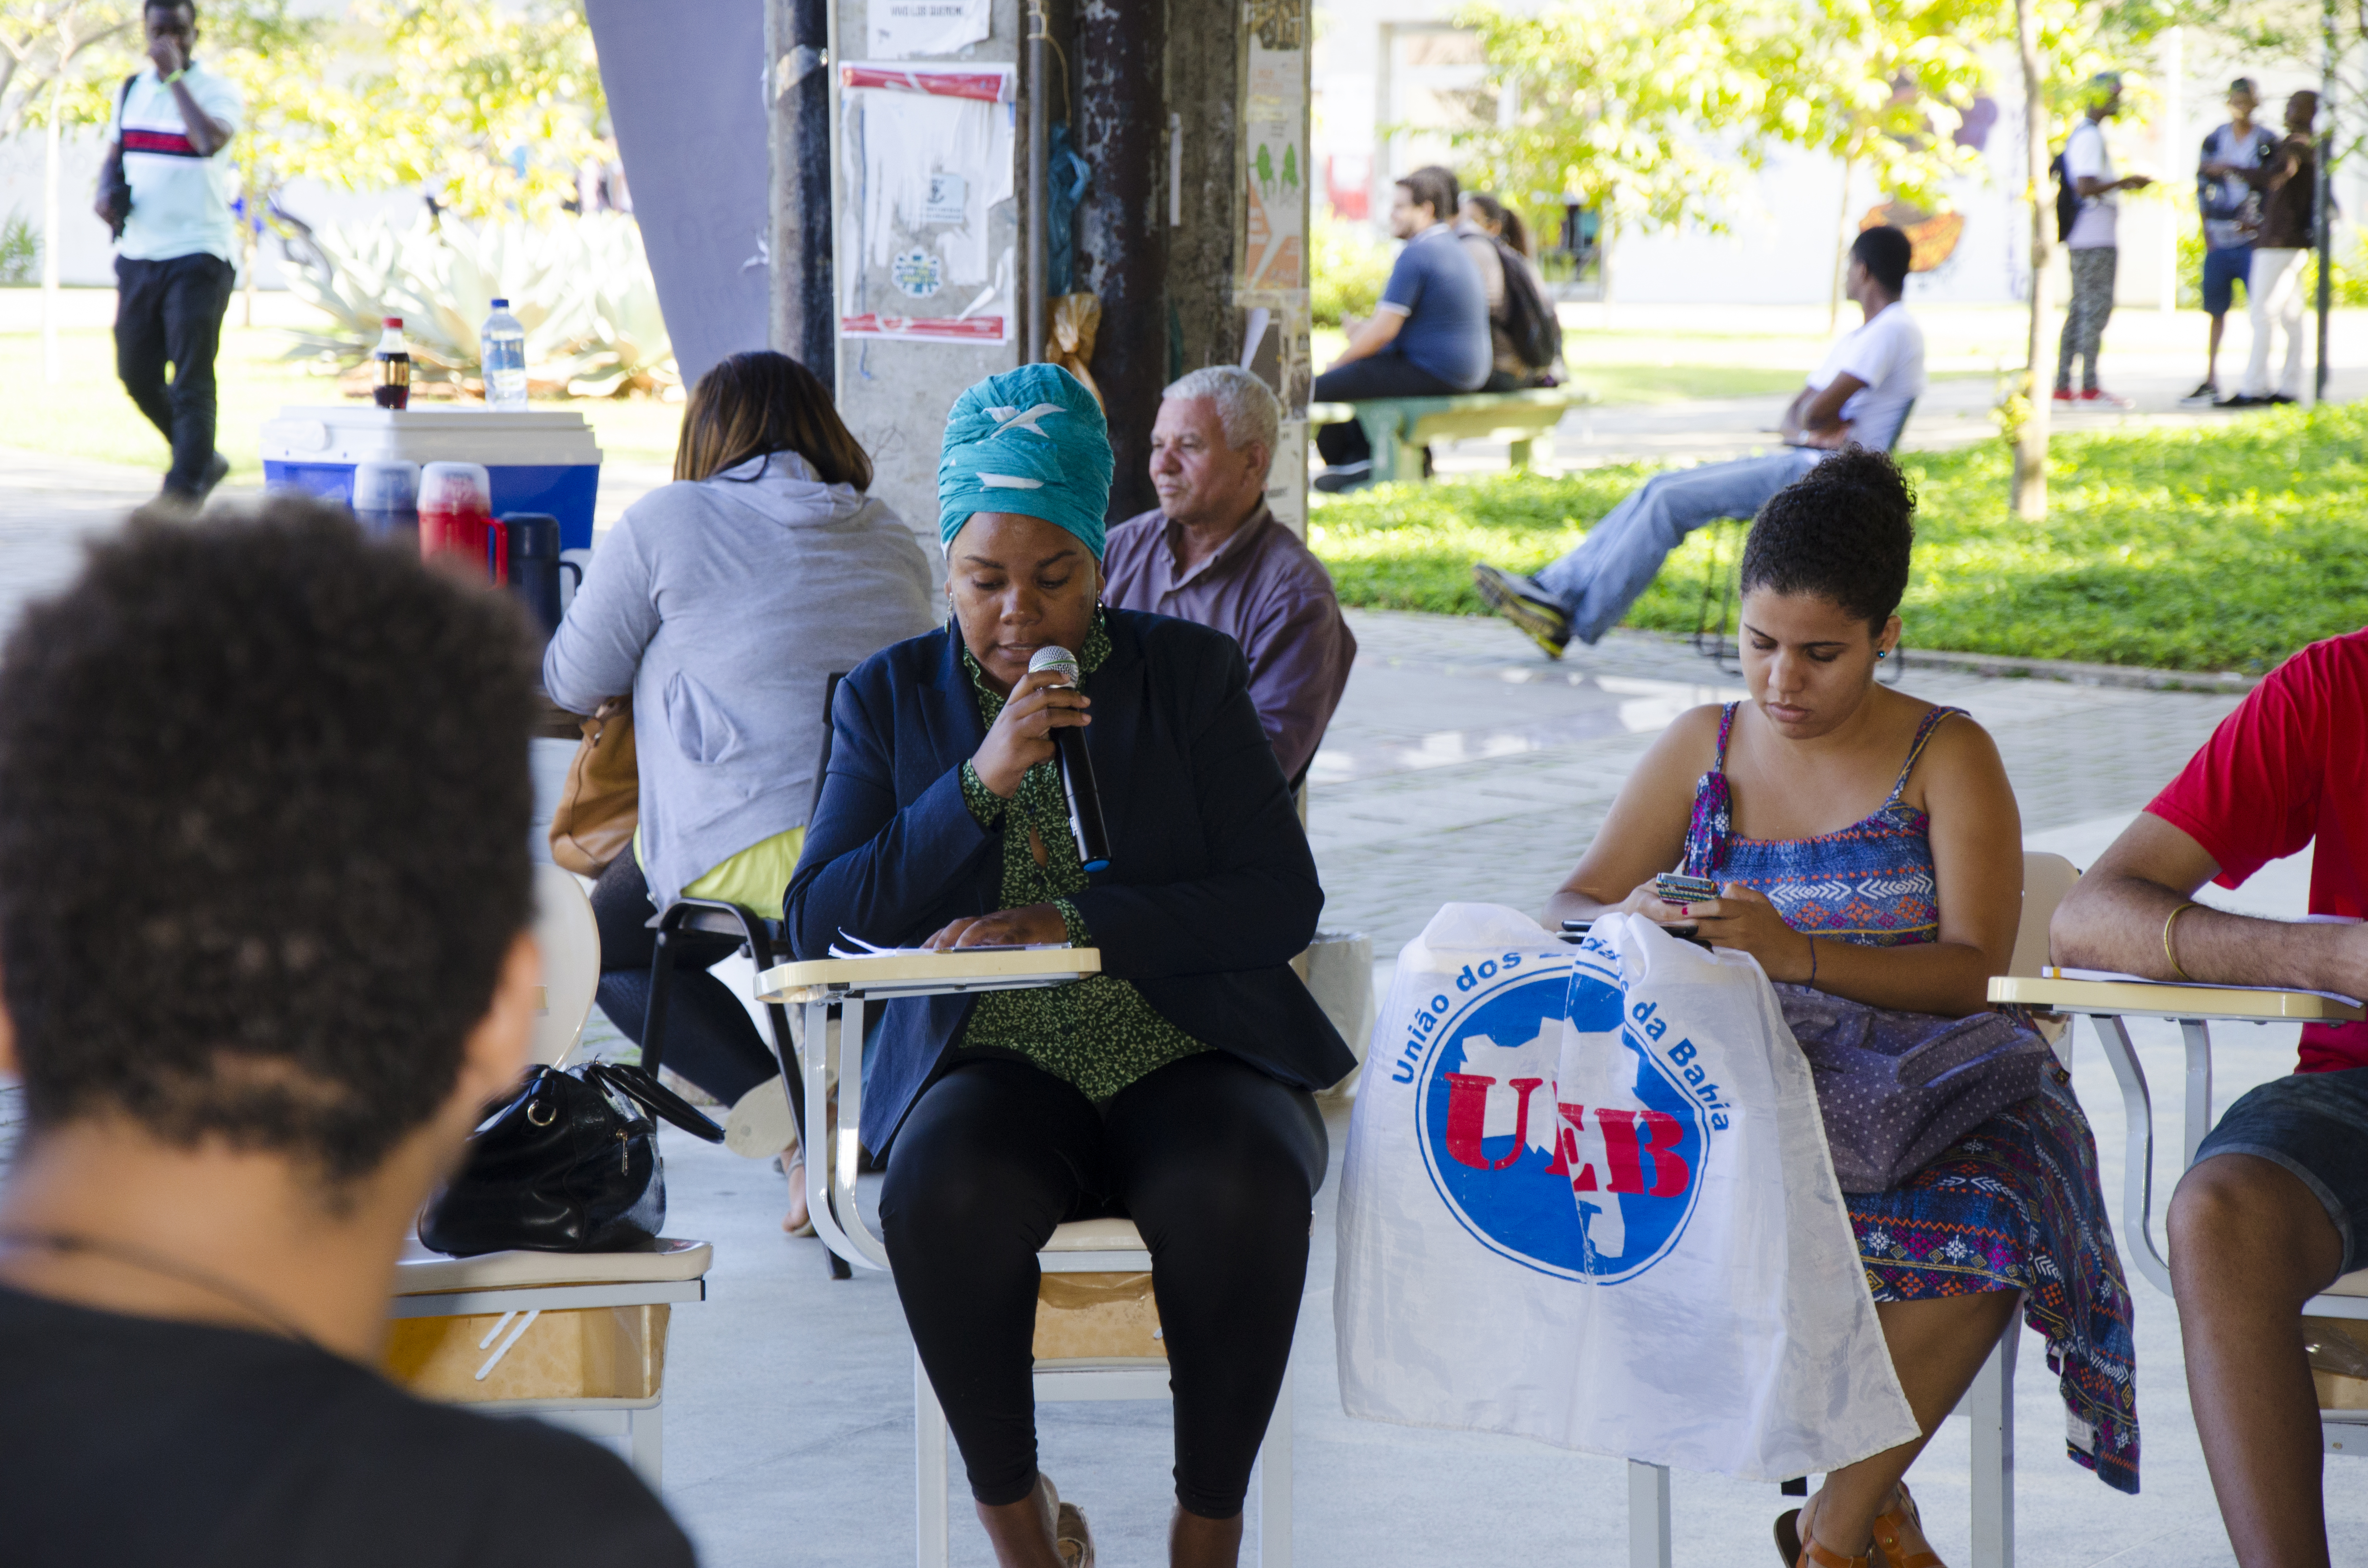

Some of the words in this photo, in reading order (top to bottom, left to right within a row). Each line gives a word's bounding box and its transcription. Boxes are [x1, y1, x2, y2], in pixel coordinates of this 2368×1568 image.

[1392, 994, 1450, 1085] União
[1455, 952, 1522, 992] dos
[1631, 1001, 1667, 1042] da
[1667, 1037, 1730, 1132] Bahia
[1445, 1073, 1690, 1198] UEB
